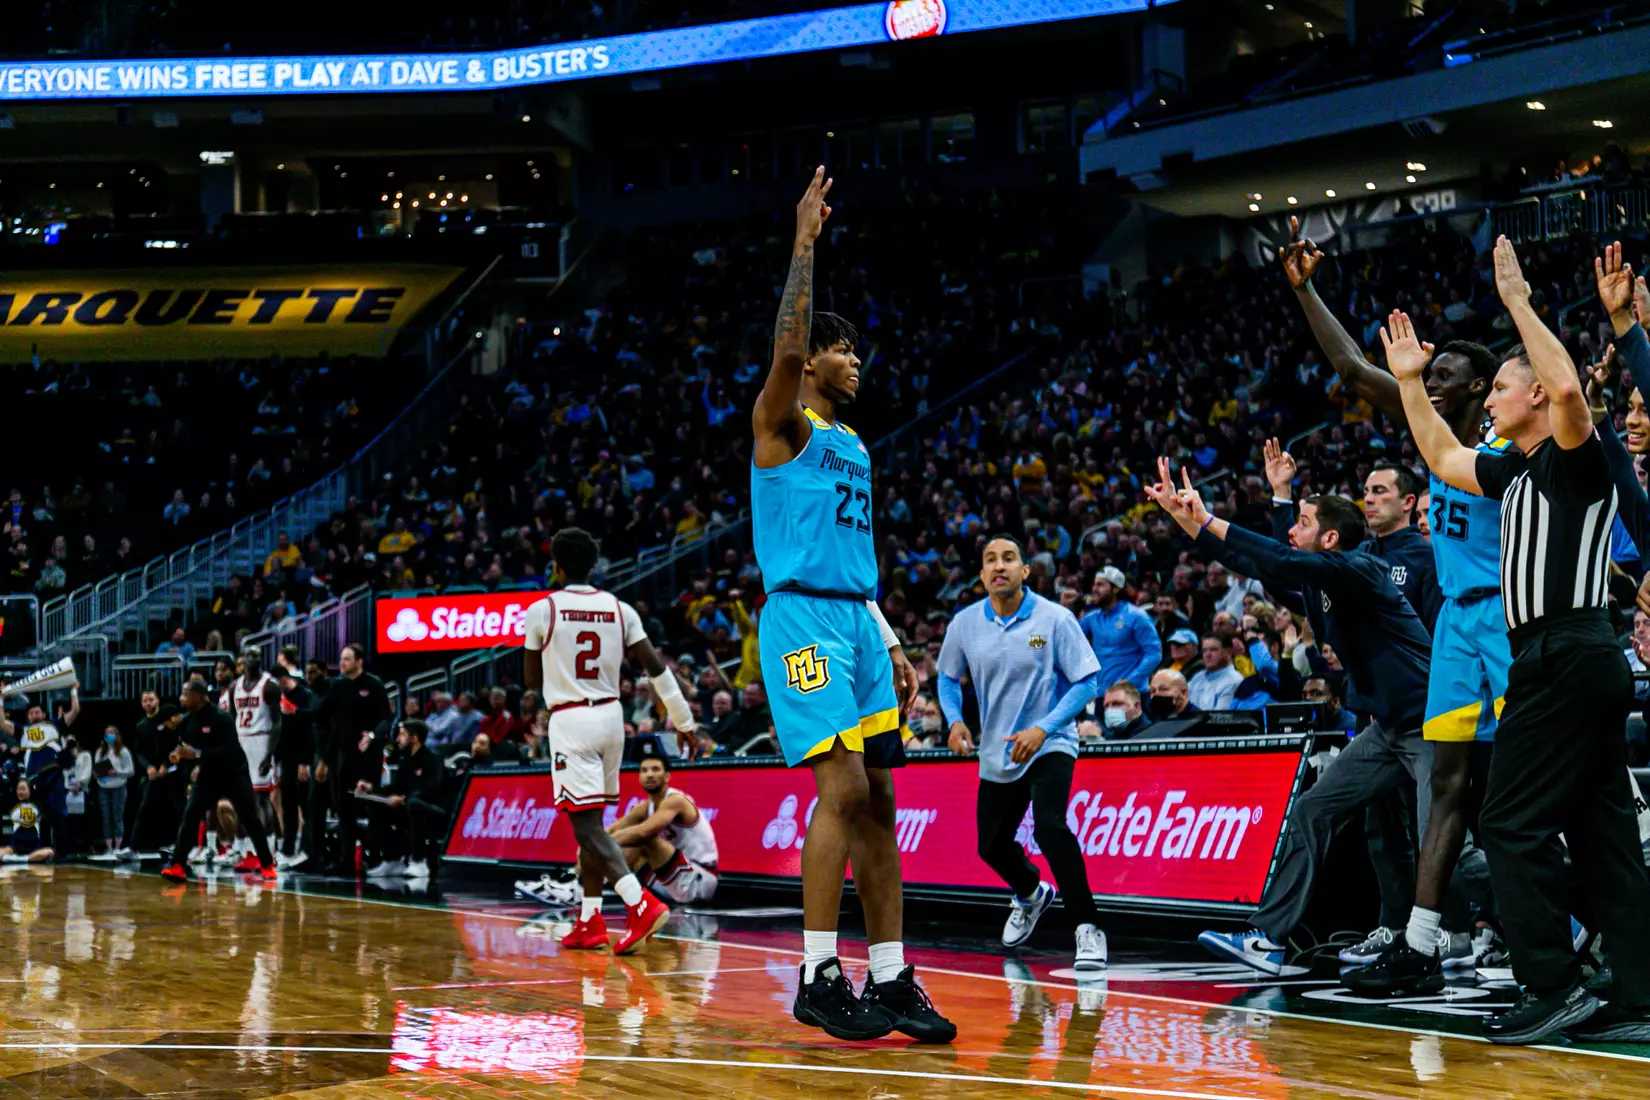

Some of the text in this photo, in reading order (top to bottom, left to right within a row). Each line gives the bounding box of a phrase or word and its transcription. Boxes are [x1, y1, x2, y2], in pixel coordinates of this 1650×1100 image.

[117, 65, 189, 90] WINS
[195, 63, 248, 89] FREE
[274, 61, 346, 88] PLAY
[351, 61, 385, 85] AT
[390, 60, 460, 85] DAVE
[465, 59, 486, 83] &
[493, 45, 610, 82] BUSTER'S
[835, 481, 871, 535] 23
[1431, 494, 1469, 541] 35
[430, 603, 527, 640] StateFa
[575, 631, 601, 680] 2
[781, 643, 831, 695] MU
[239, 710, 253, 729] 12
